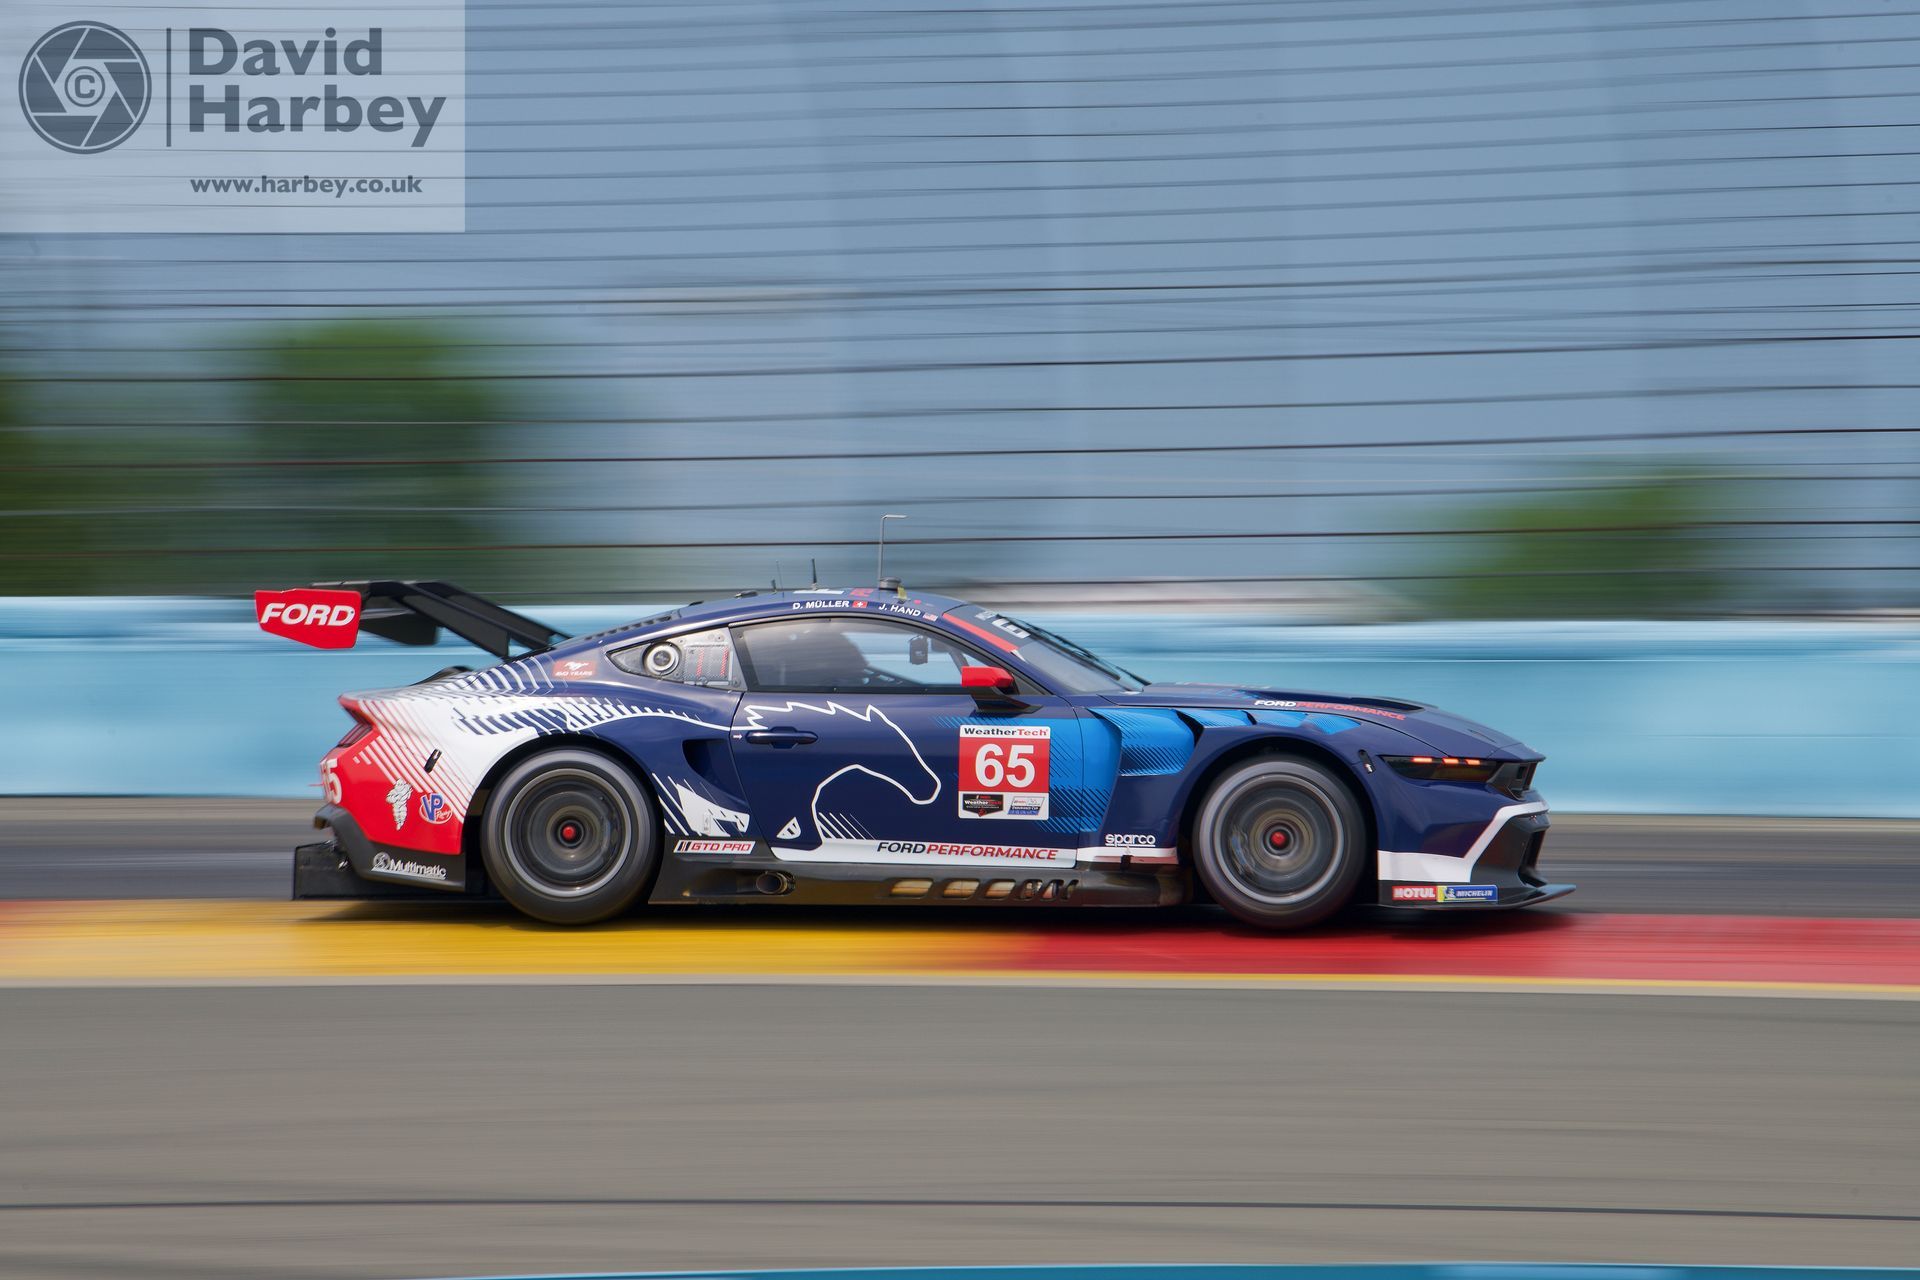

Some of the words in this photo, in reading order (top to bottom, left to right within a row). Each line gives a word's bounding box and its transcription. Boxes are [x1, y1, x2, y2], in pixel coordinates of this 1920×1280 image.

[792, 602, 803, 610] D.
[806, 599, 850, 609] MÜLLER
[878, 603, 887, 611] J.
[890, 604, 921, 617] HAND
[260, 602, 356, 627] FORD
[964, 727, 1048, 737] WeatherTech
[975, 743, 1036, 788] 65
[420, 793, 444, 822] VP
[1105, 833, 1156, 846] sparco
[690, 842, 720, 851] GTD
[722, 843, 751, 852] PRO
[390, 858, 447, 877] Multimatic
[1393, 887, 1436, 898] MOTUL
